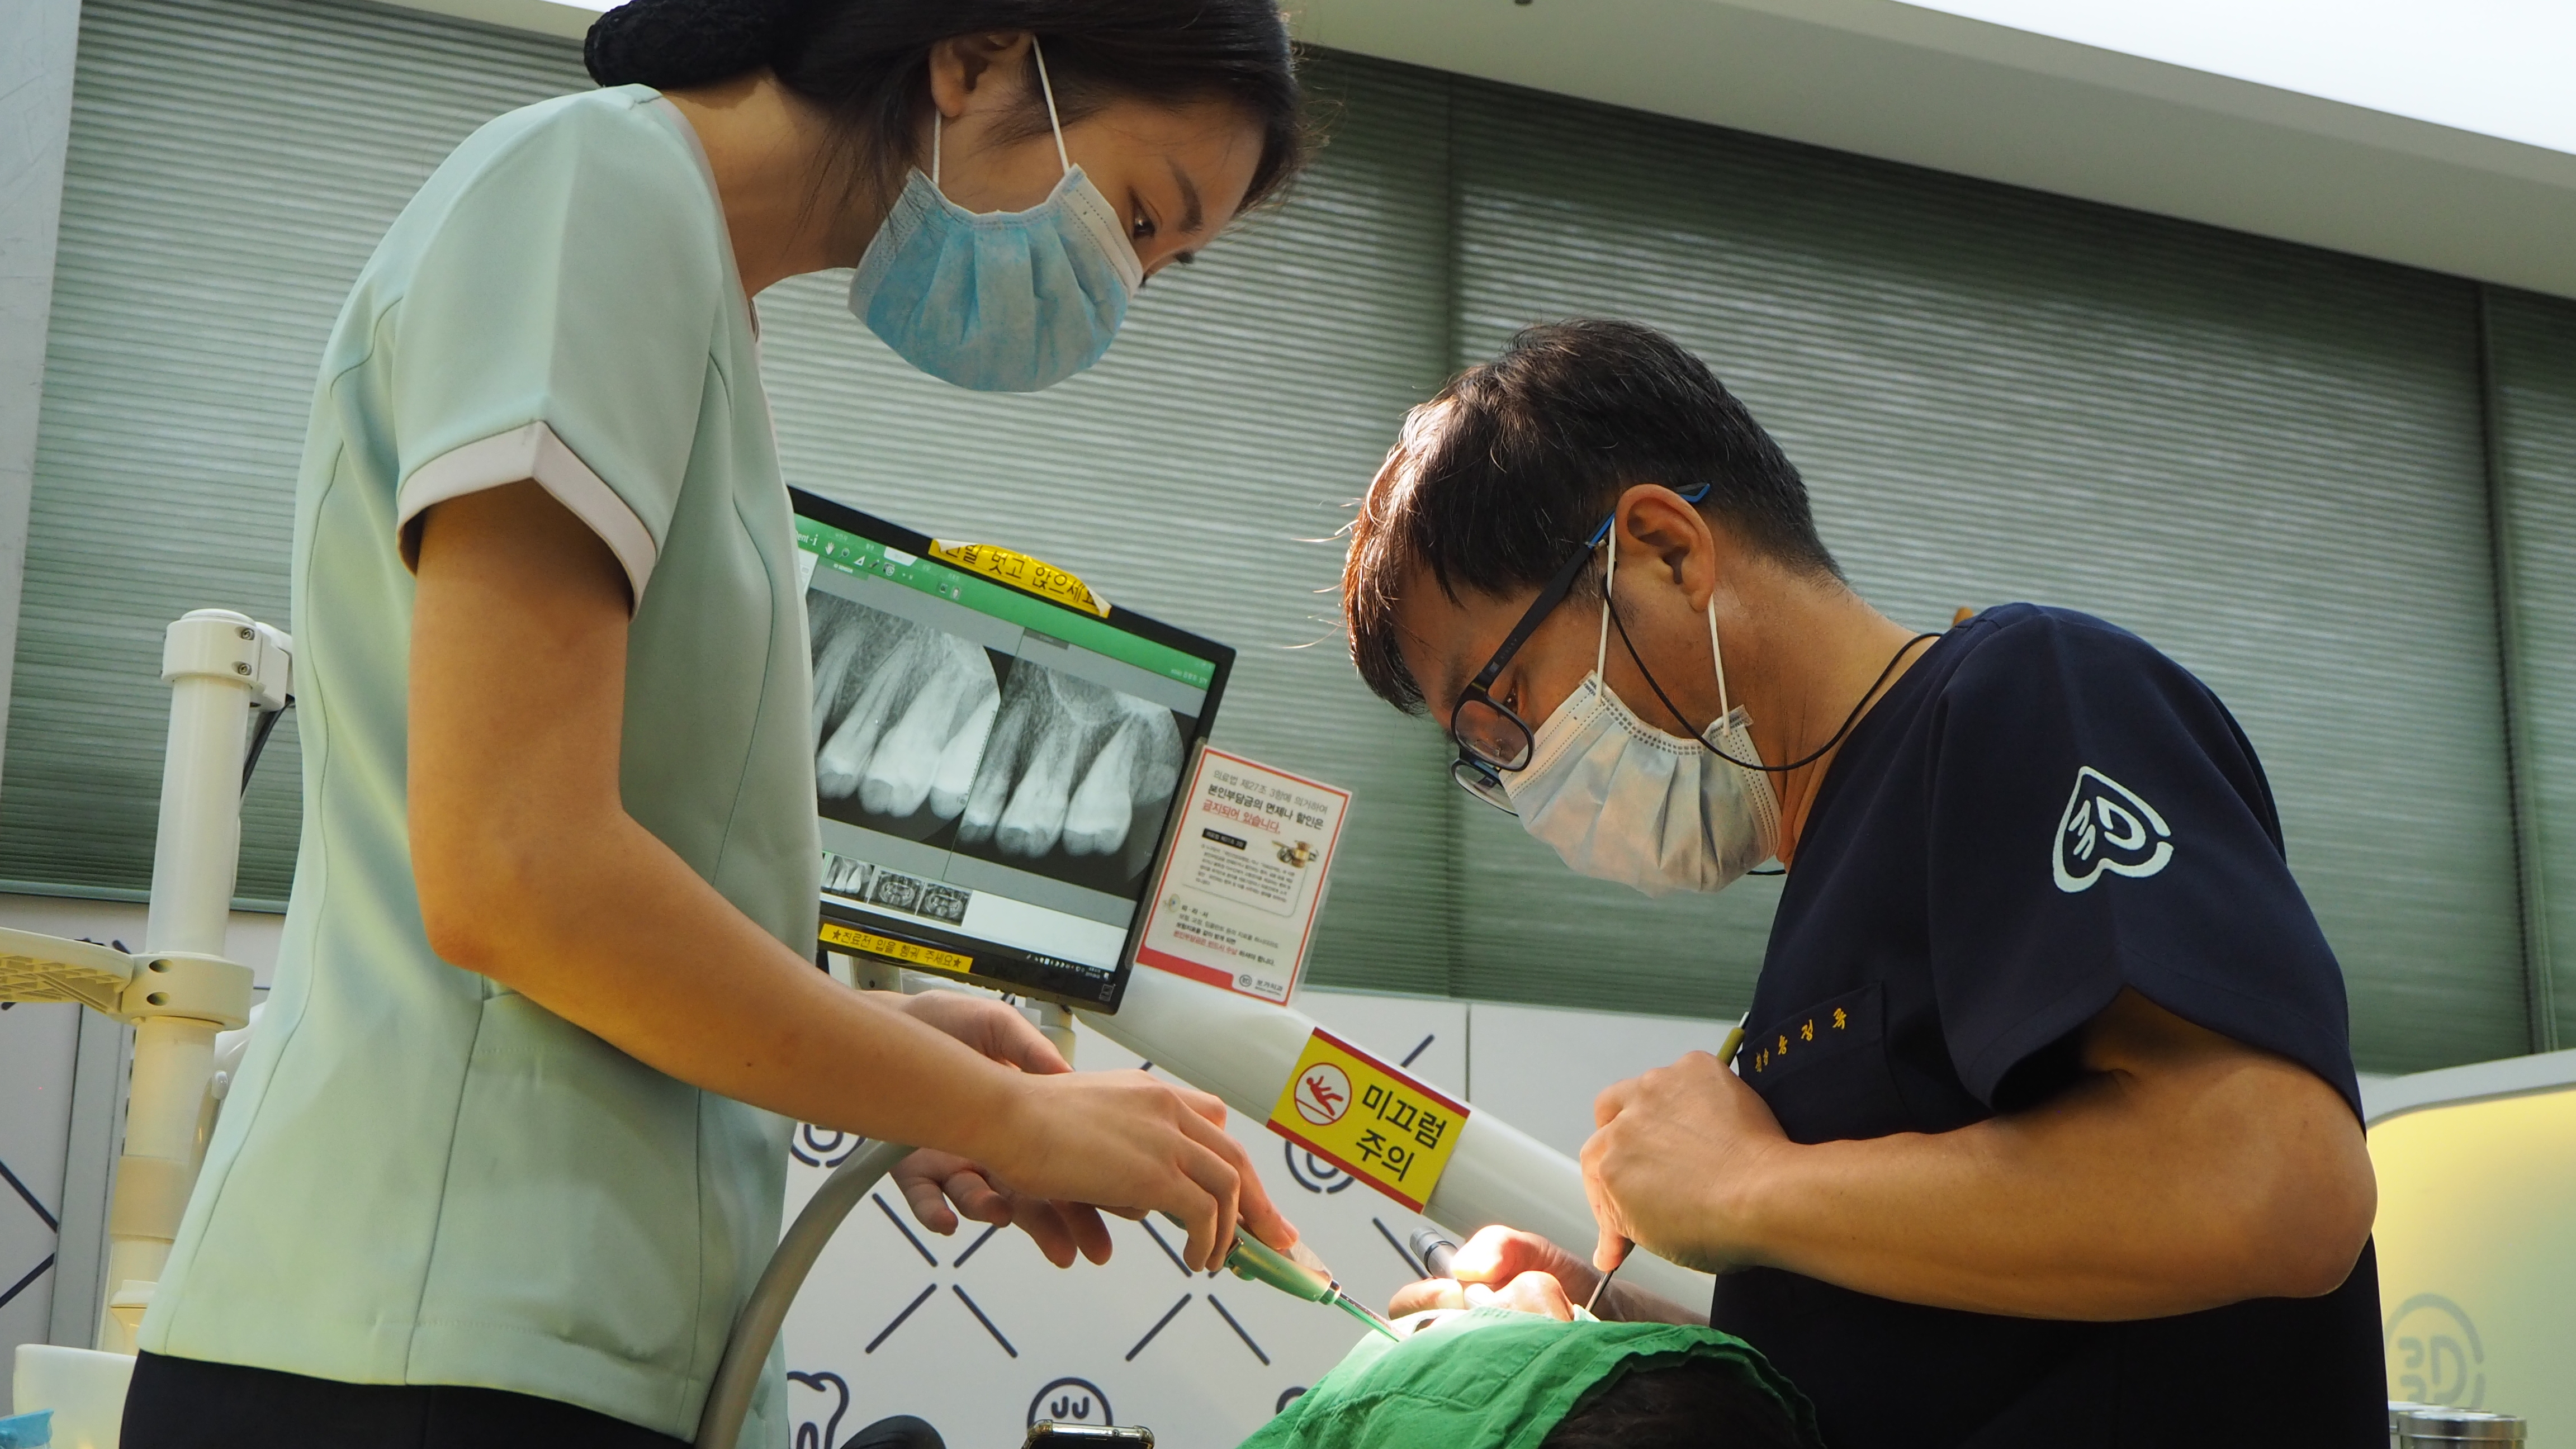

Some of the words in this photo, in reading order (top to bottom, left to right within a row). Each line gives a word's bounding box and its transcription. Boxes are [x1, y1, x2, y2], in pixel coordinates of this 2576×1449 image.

[794, 529, 818, 546] ent-i
[988, 552, 1025, 580] 벗고
[1208, 784, 1263, 809] 본인부담금의
[1265, 803, 1293, 818] 면제나
[1296, 813, 1323, 829] 할인은
[1213, 771, 1238, 785] 의료법
[1240, 779, 1267, 793] 제27조
[1270, 789, 1291, 802] 3항에
[1294, 797, 1328, 813] 의거하여
[1202, 799, 1240, 818] 금지되어
[1242, 812, 1282, 832] 있습니다.
[876, 940, 895, 953] 입을
[1362, 1083, 1447, 1150] 미끄럼
[1356, 1128, 1415, 1182] 주의
